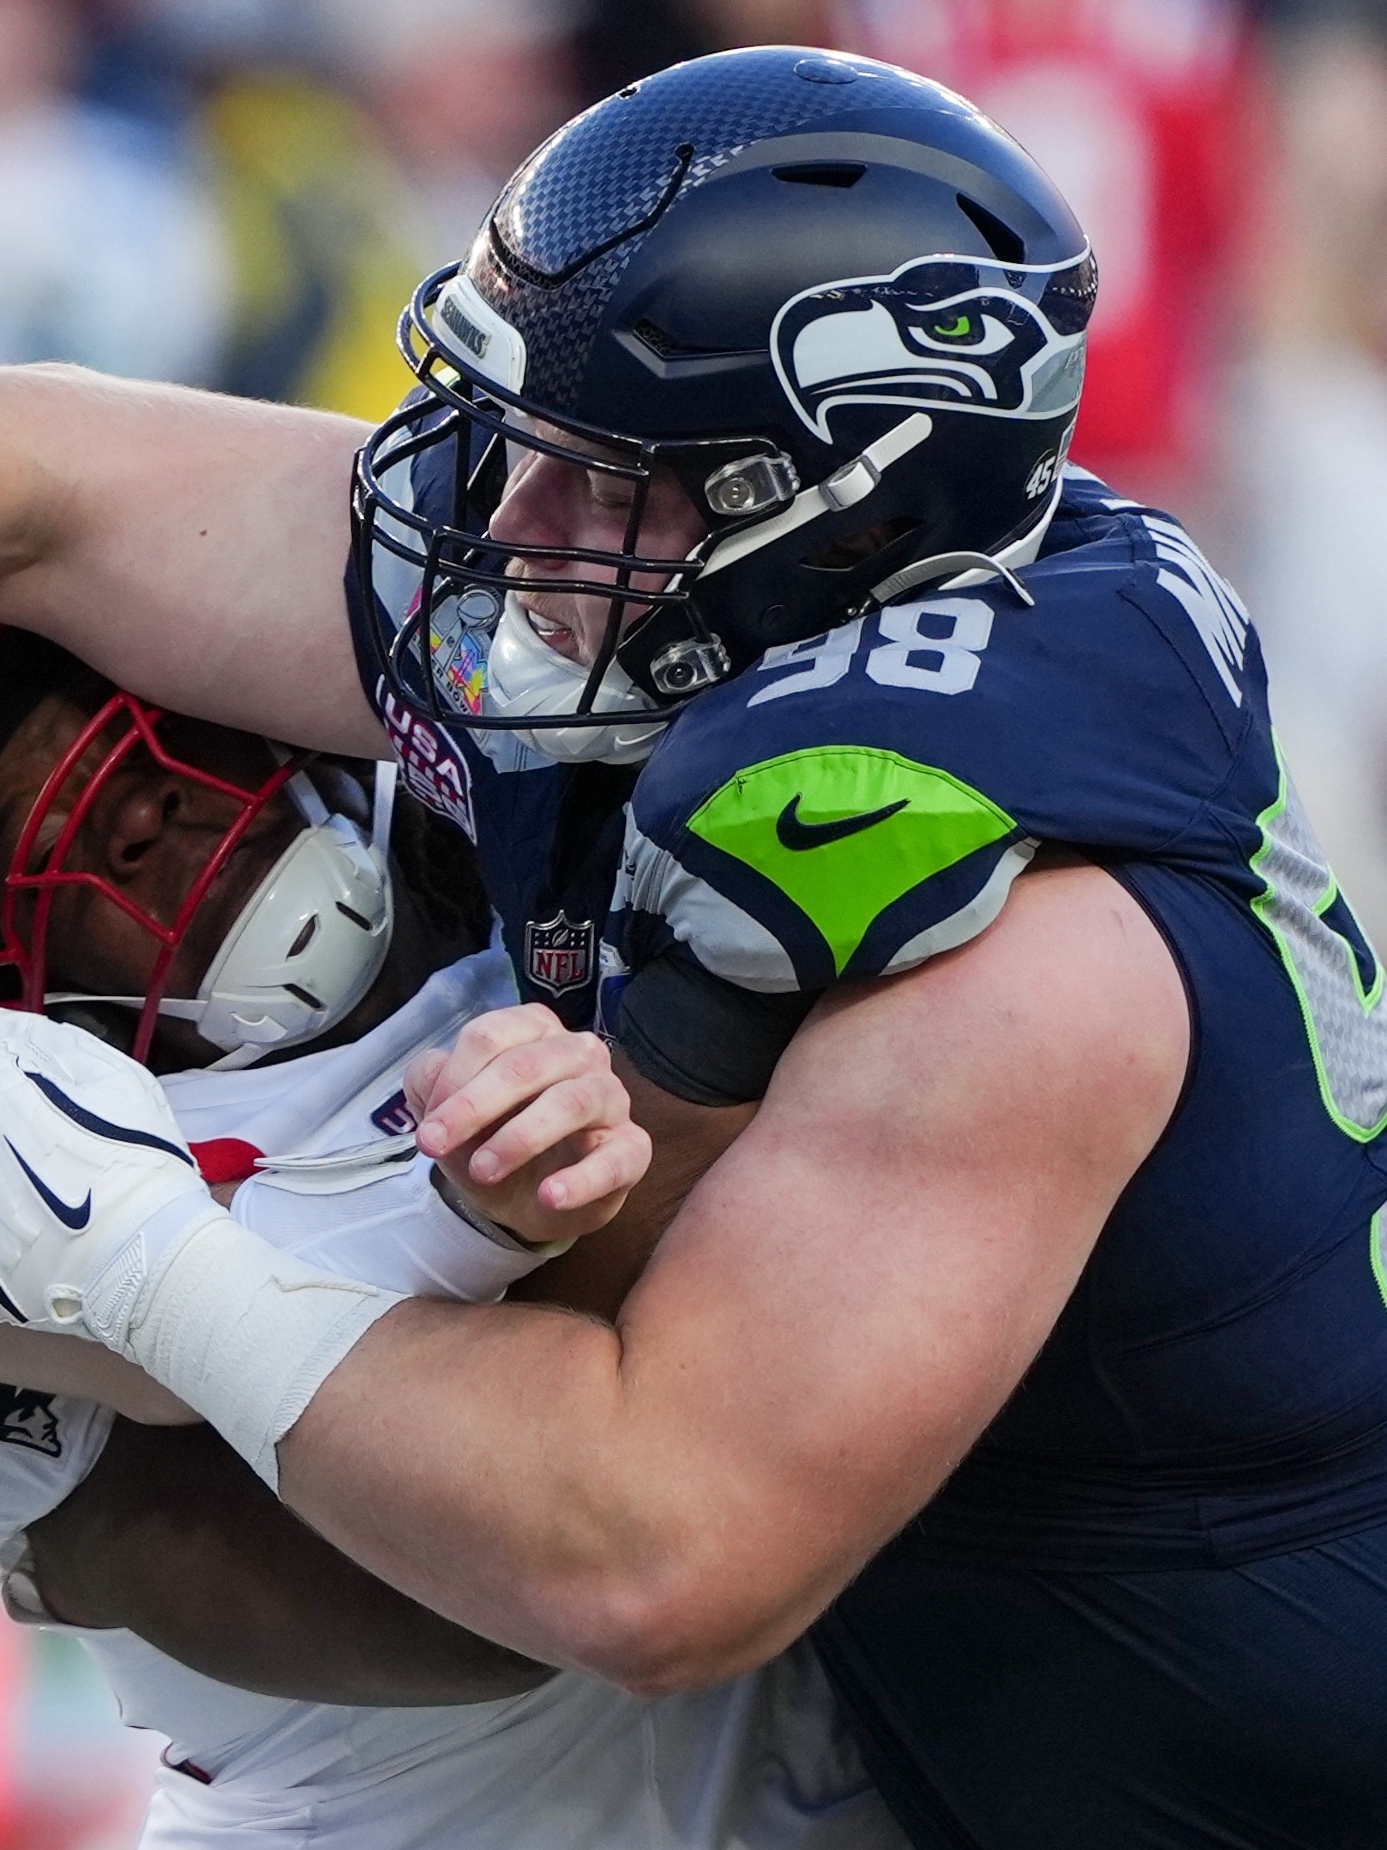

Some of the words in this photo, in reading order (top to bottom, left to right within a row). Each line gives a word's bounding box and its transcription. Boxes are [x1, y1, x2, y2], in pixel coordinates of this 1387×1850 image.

[1025, 455, 1056, 500] 45
[746, 597, 996, 708] 98
[385, 692, 463, 797] USA
[535, 952, 584, 982] NFL
